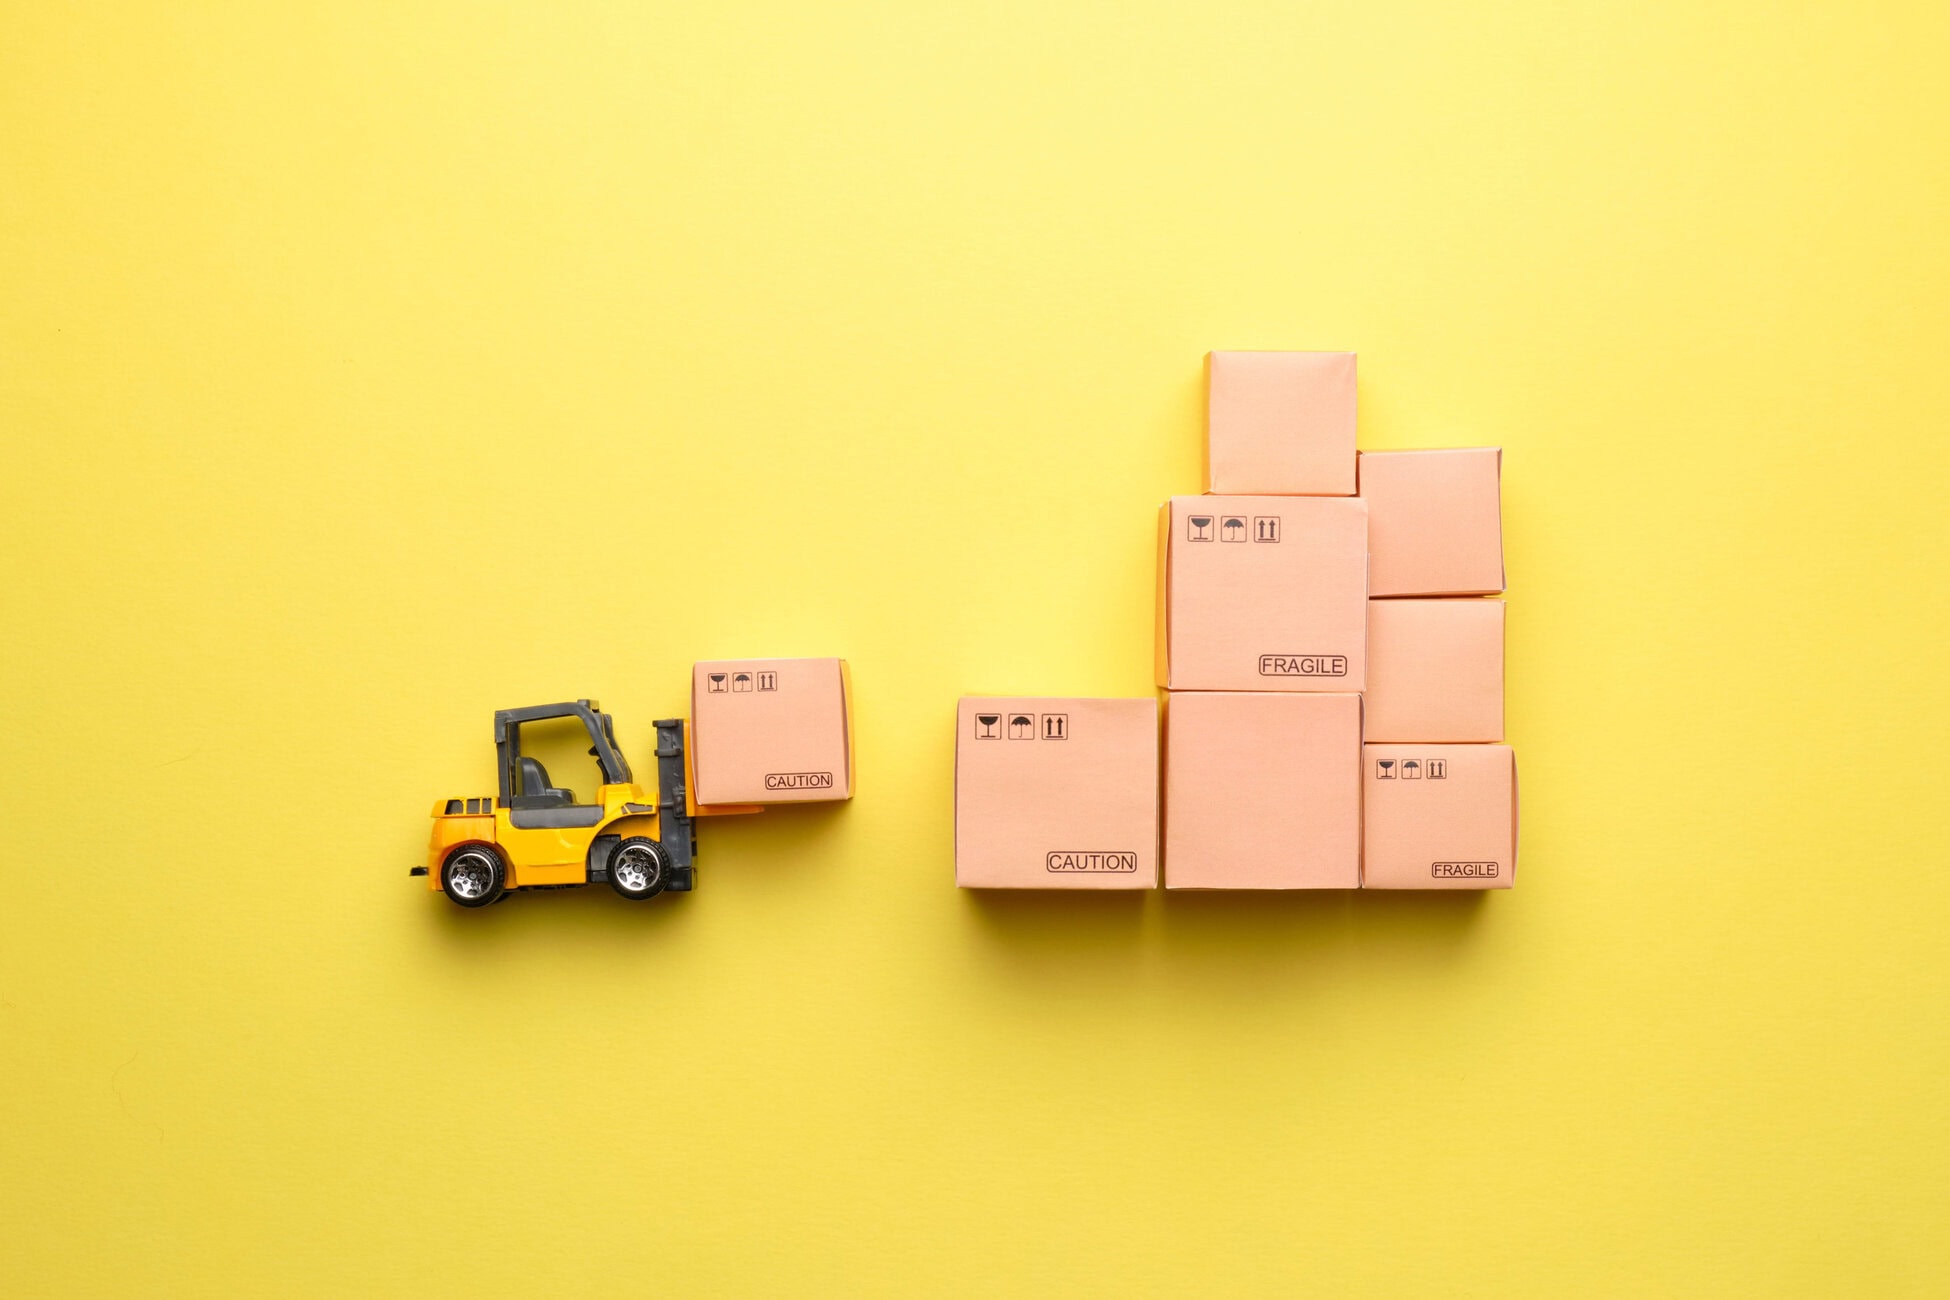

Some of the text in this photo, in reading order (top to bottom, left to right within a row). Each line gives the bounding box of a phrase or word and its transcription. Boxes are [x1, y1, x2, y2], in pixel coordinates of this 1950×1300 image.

[1262, 657, 1343, 673] FRAGILE
[767, 774, 830, 787] CAUTION
[1049, 854, 1134, 869] CAUTION
[1434, 864, 1496, 876] FRAGILE
